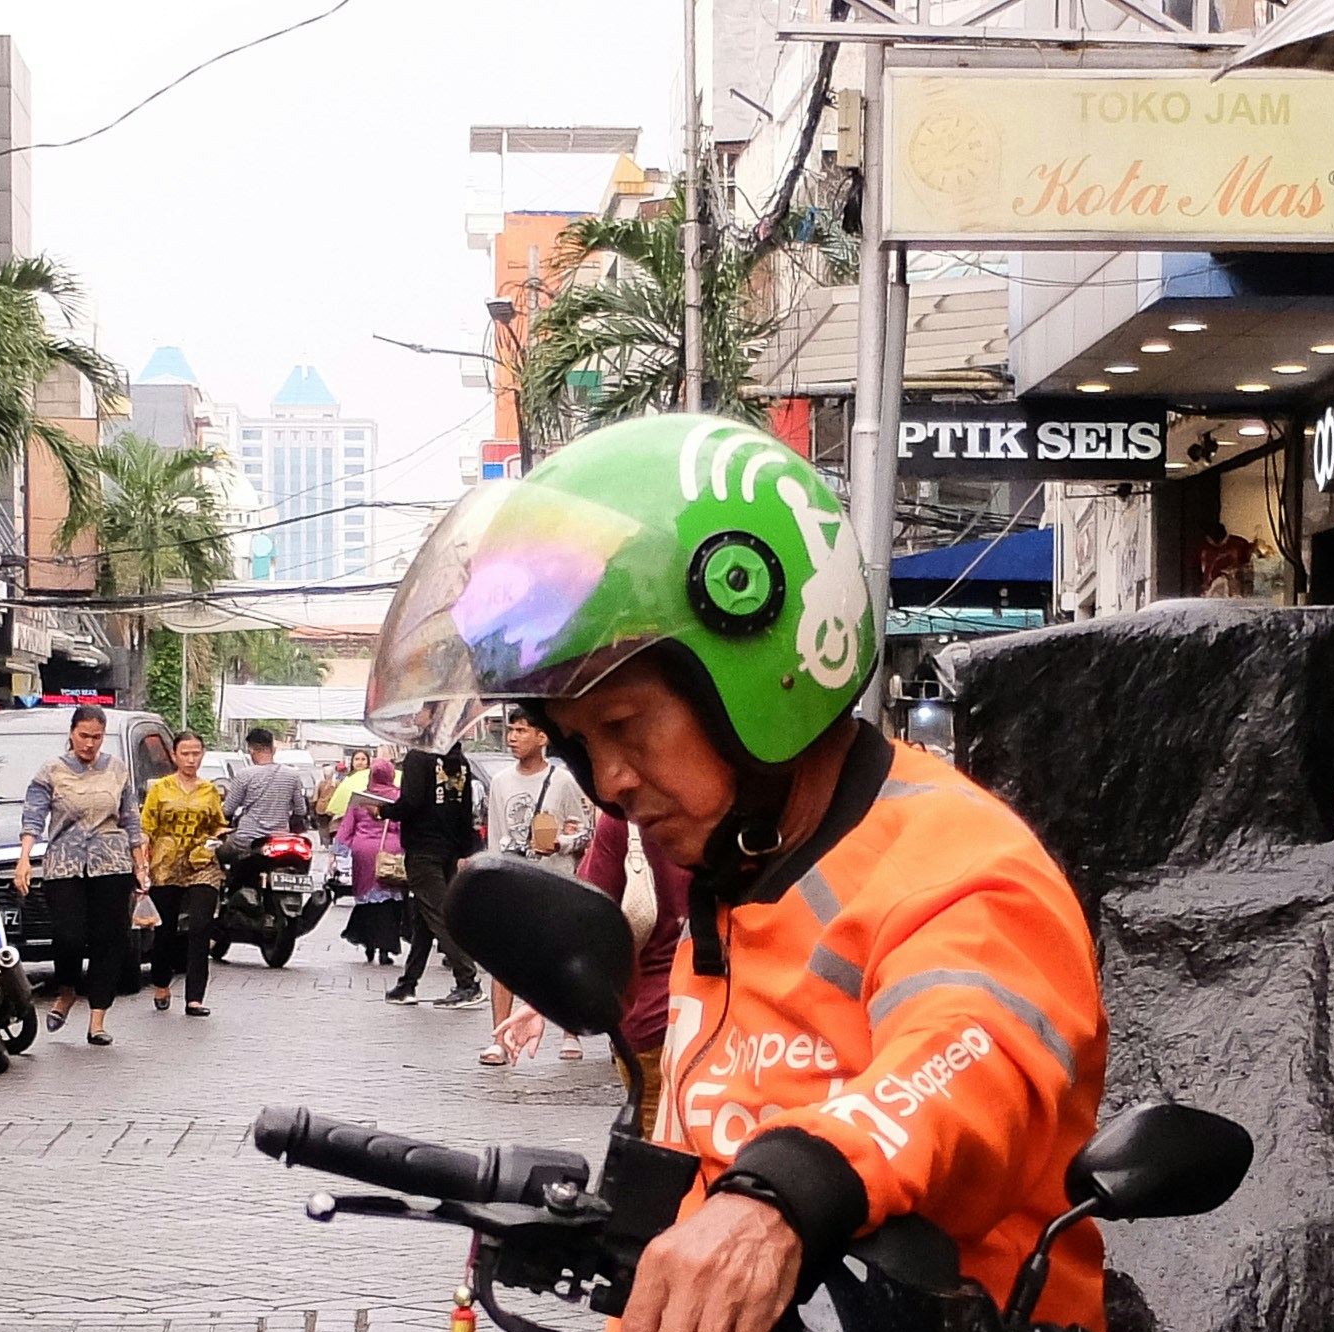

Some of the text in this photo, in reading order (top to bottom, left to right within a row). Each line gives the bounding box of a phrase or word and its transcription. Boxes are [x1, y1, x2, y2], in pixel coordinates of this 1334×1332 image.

[1072, 91, 1290, 126] TOKO JAM
[1012, 154, 1325, 219] Kota Mas
[1036, 421, 1162, 460] SEIS
[710, 1026, 838, 1086] Shopee
